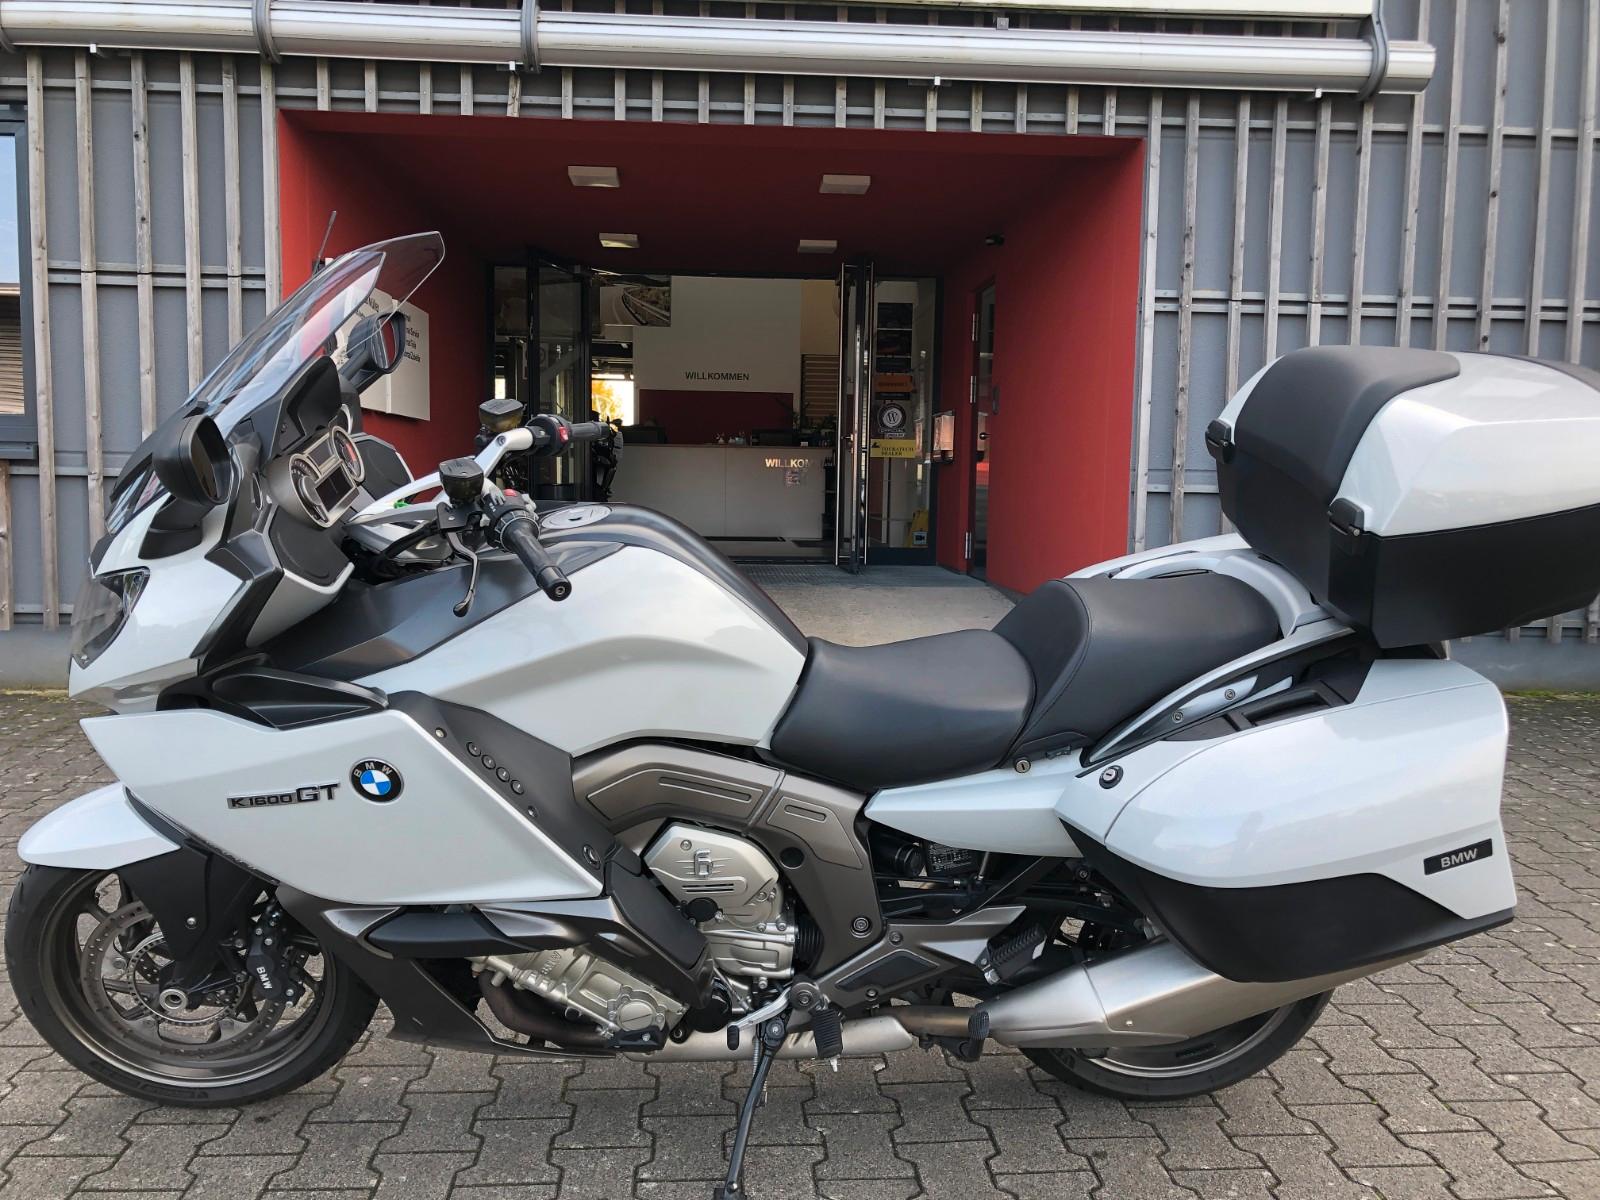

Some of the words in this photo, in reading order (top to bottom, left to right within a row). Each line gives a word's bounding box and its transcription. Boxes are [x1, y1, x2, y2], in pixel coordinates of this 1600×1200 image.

[685, 371, 750, 381] WILLKOMMEN
[765, 458, 809, 468] WILLKO
[353, 762, 393, 778] BMW
[1440, 848, 1478, 868] BMW
[541, 950, 561, 975] BMW
[256, 966, 273, 989] BMW
